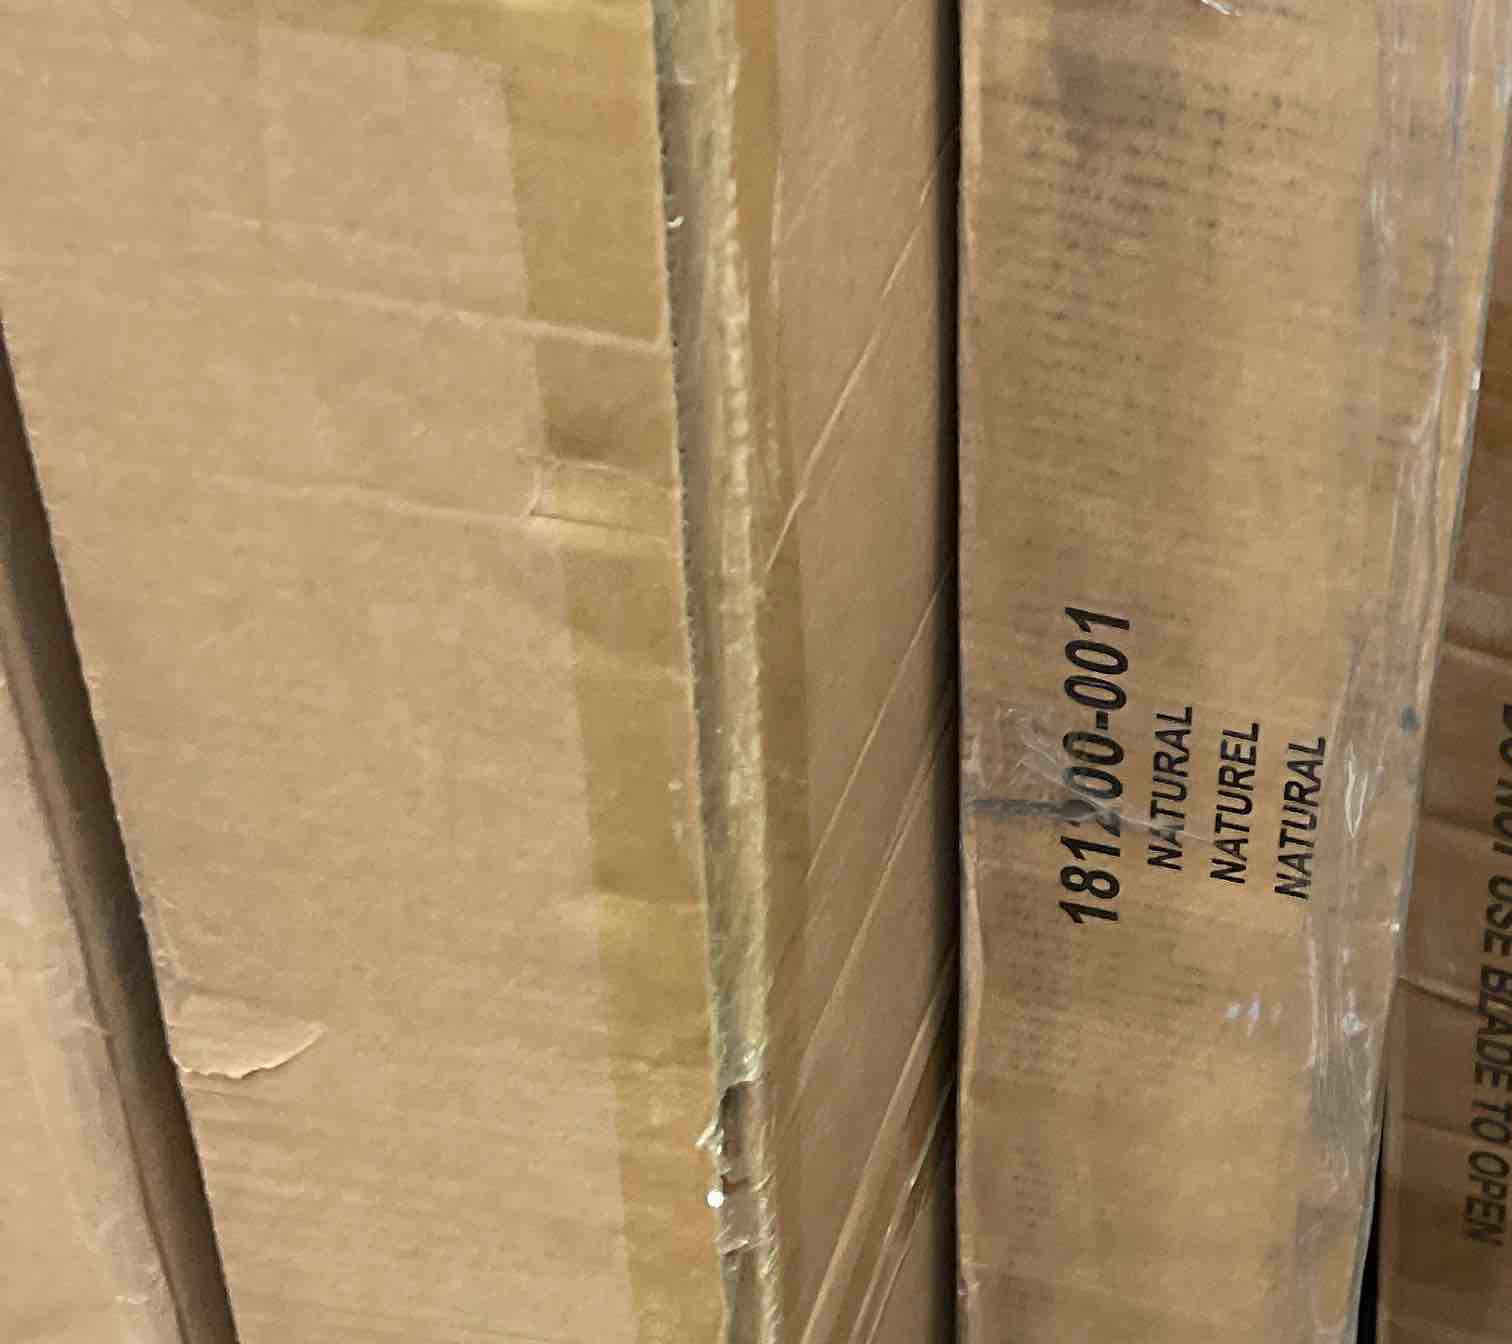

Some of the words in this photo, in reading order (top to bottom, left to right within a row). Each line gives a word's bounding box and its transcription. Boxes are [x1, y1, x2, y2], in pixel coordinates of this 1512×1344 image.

[1147, 705, 1193, 871] NATURAL
[1210, 722, 1260, 884] NATUREL
[1273, 736, 1326, 901] NATURAL
[1463, 1150, 1511, 1247] OPEN
[1470, 1099, 1512, 1145] TO
